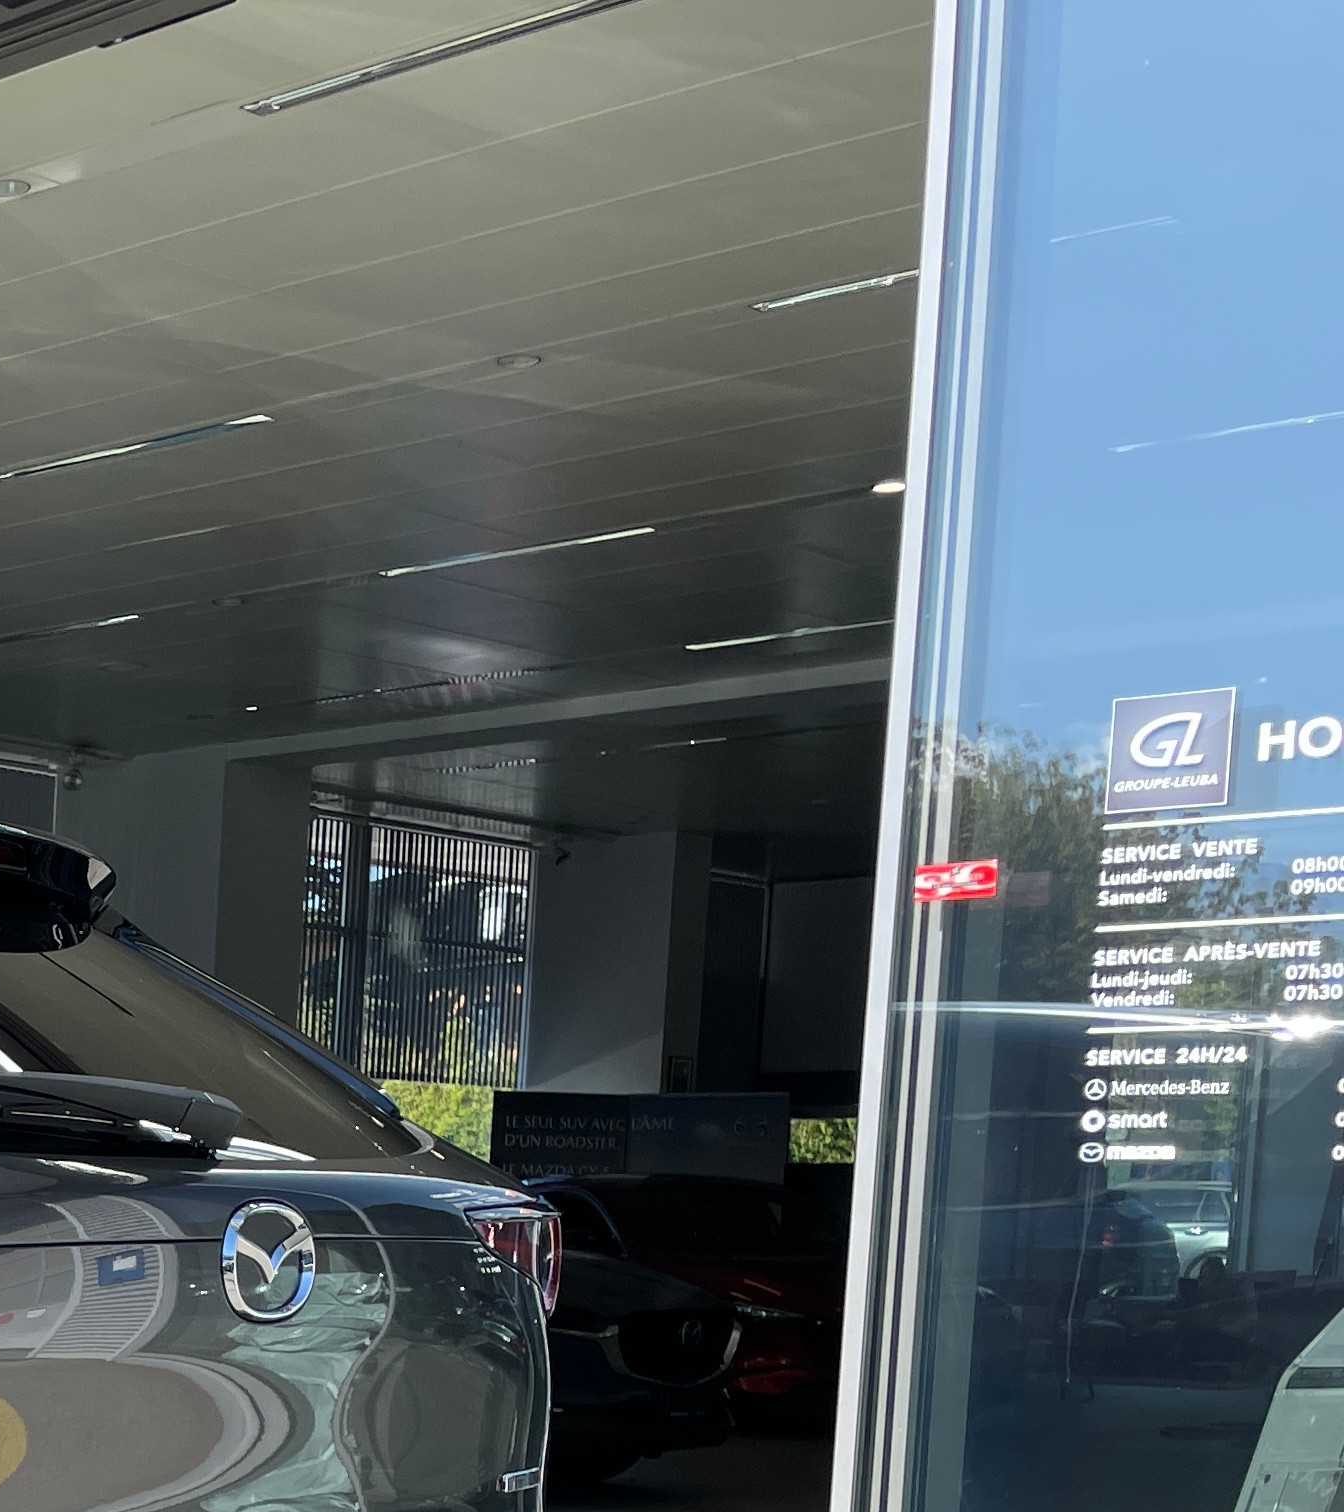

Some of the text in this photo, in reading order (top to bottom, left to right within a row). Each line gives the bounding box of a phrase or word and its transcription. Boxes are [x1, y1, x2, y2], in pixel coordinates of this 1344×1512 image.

[1130, 711, 1204, 767] GL
[1257, 716, 1343, 762] HO
[1114, 773, 1218, 793] GROUPE-LEUBA
[1100, 838, 1259, 865] SERVICE VENTE
[1099, 862, 1236, 886] Lundi-vendredi:
[1097, 887, 1168, 906] Samedi:
[1092, 940, 1322, 967] SERVICE APRÈS-VENTE
[1090, 963, 1344, 990] Lundi-jeudi: 07h30
[1090, 984, 1344, 1008] Vendredi: 07h30
[1085, 1046, 1248, 1067] SERVICE 24H/24
[1110, 1079, 1230, 1097] Mercedes-Benz
[1107, 1110, 1169, 1129] smart
[544, 1135, 616, 1150] ROADSTER
